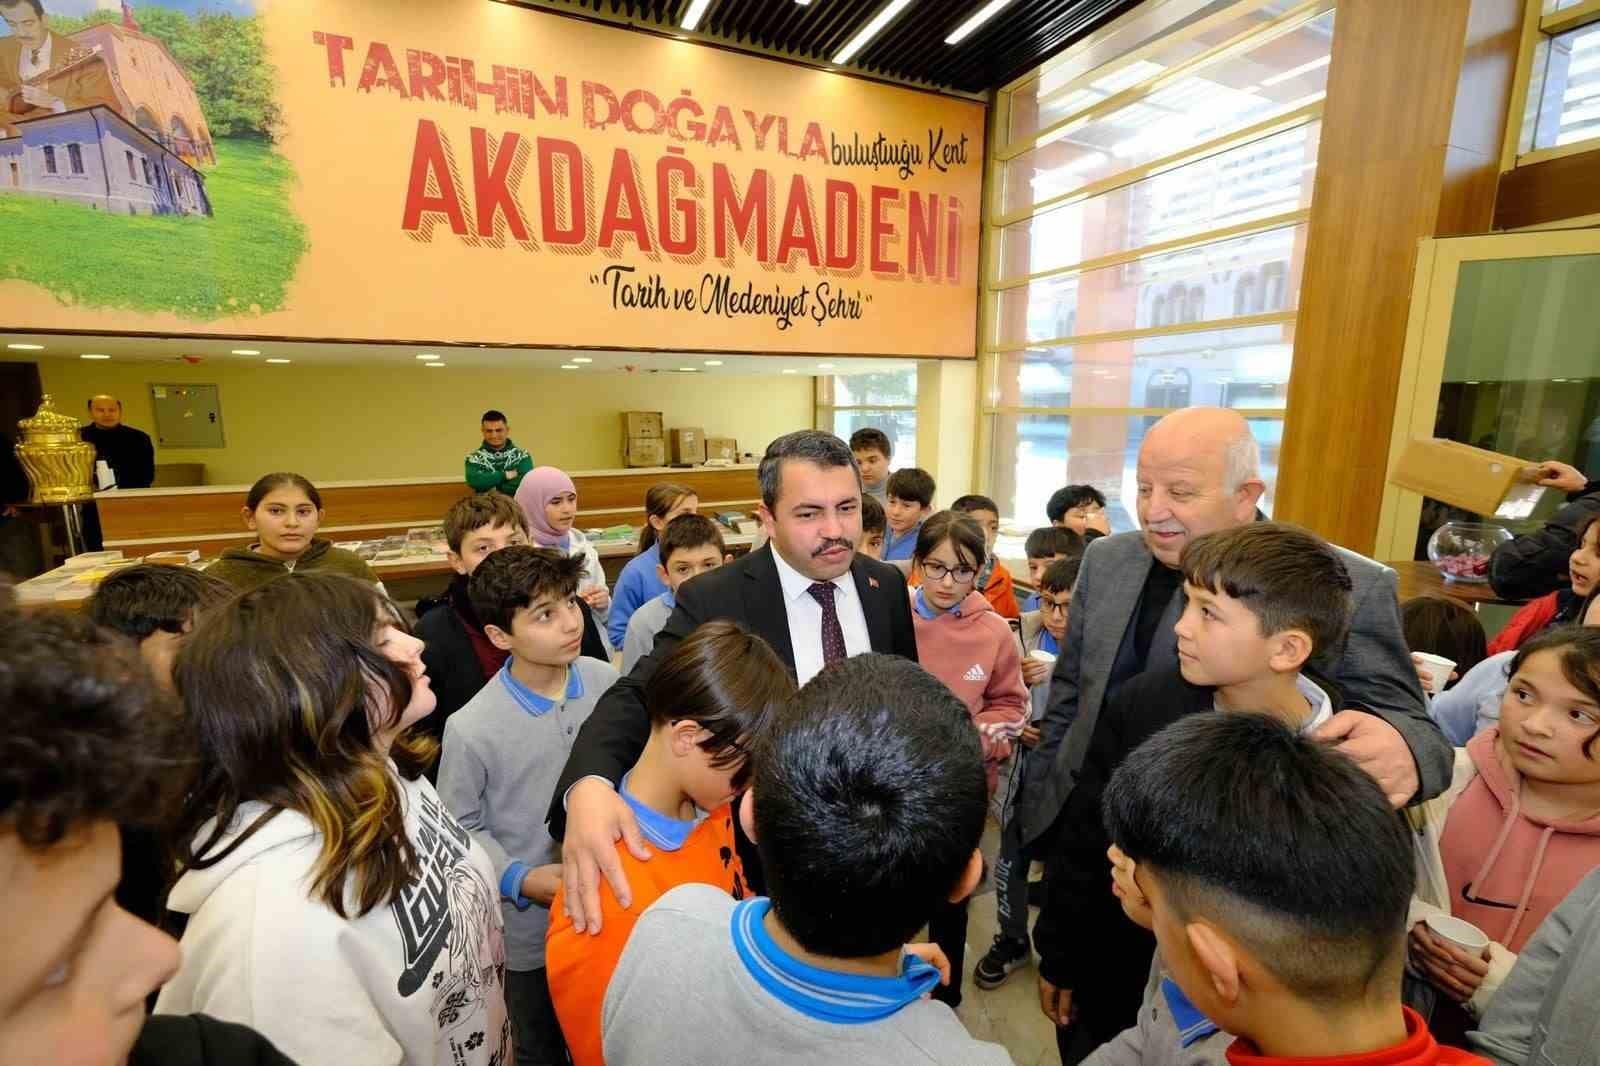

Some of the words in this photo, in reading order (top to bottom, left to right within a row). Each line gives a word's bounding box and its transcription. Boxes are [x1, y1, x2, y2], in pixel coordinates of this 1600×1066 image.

[581, 80, 829, 165] DOĞAYLA
[927, 126, 969, 174] Kent
[402, 119, 962, 282] AKDAĞMADENİ
[673, 288, 697, 311] ve
[699, 272, 810, 331] Medeniyet
